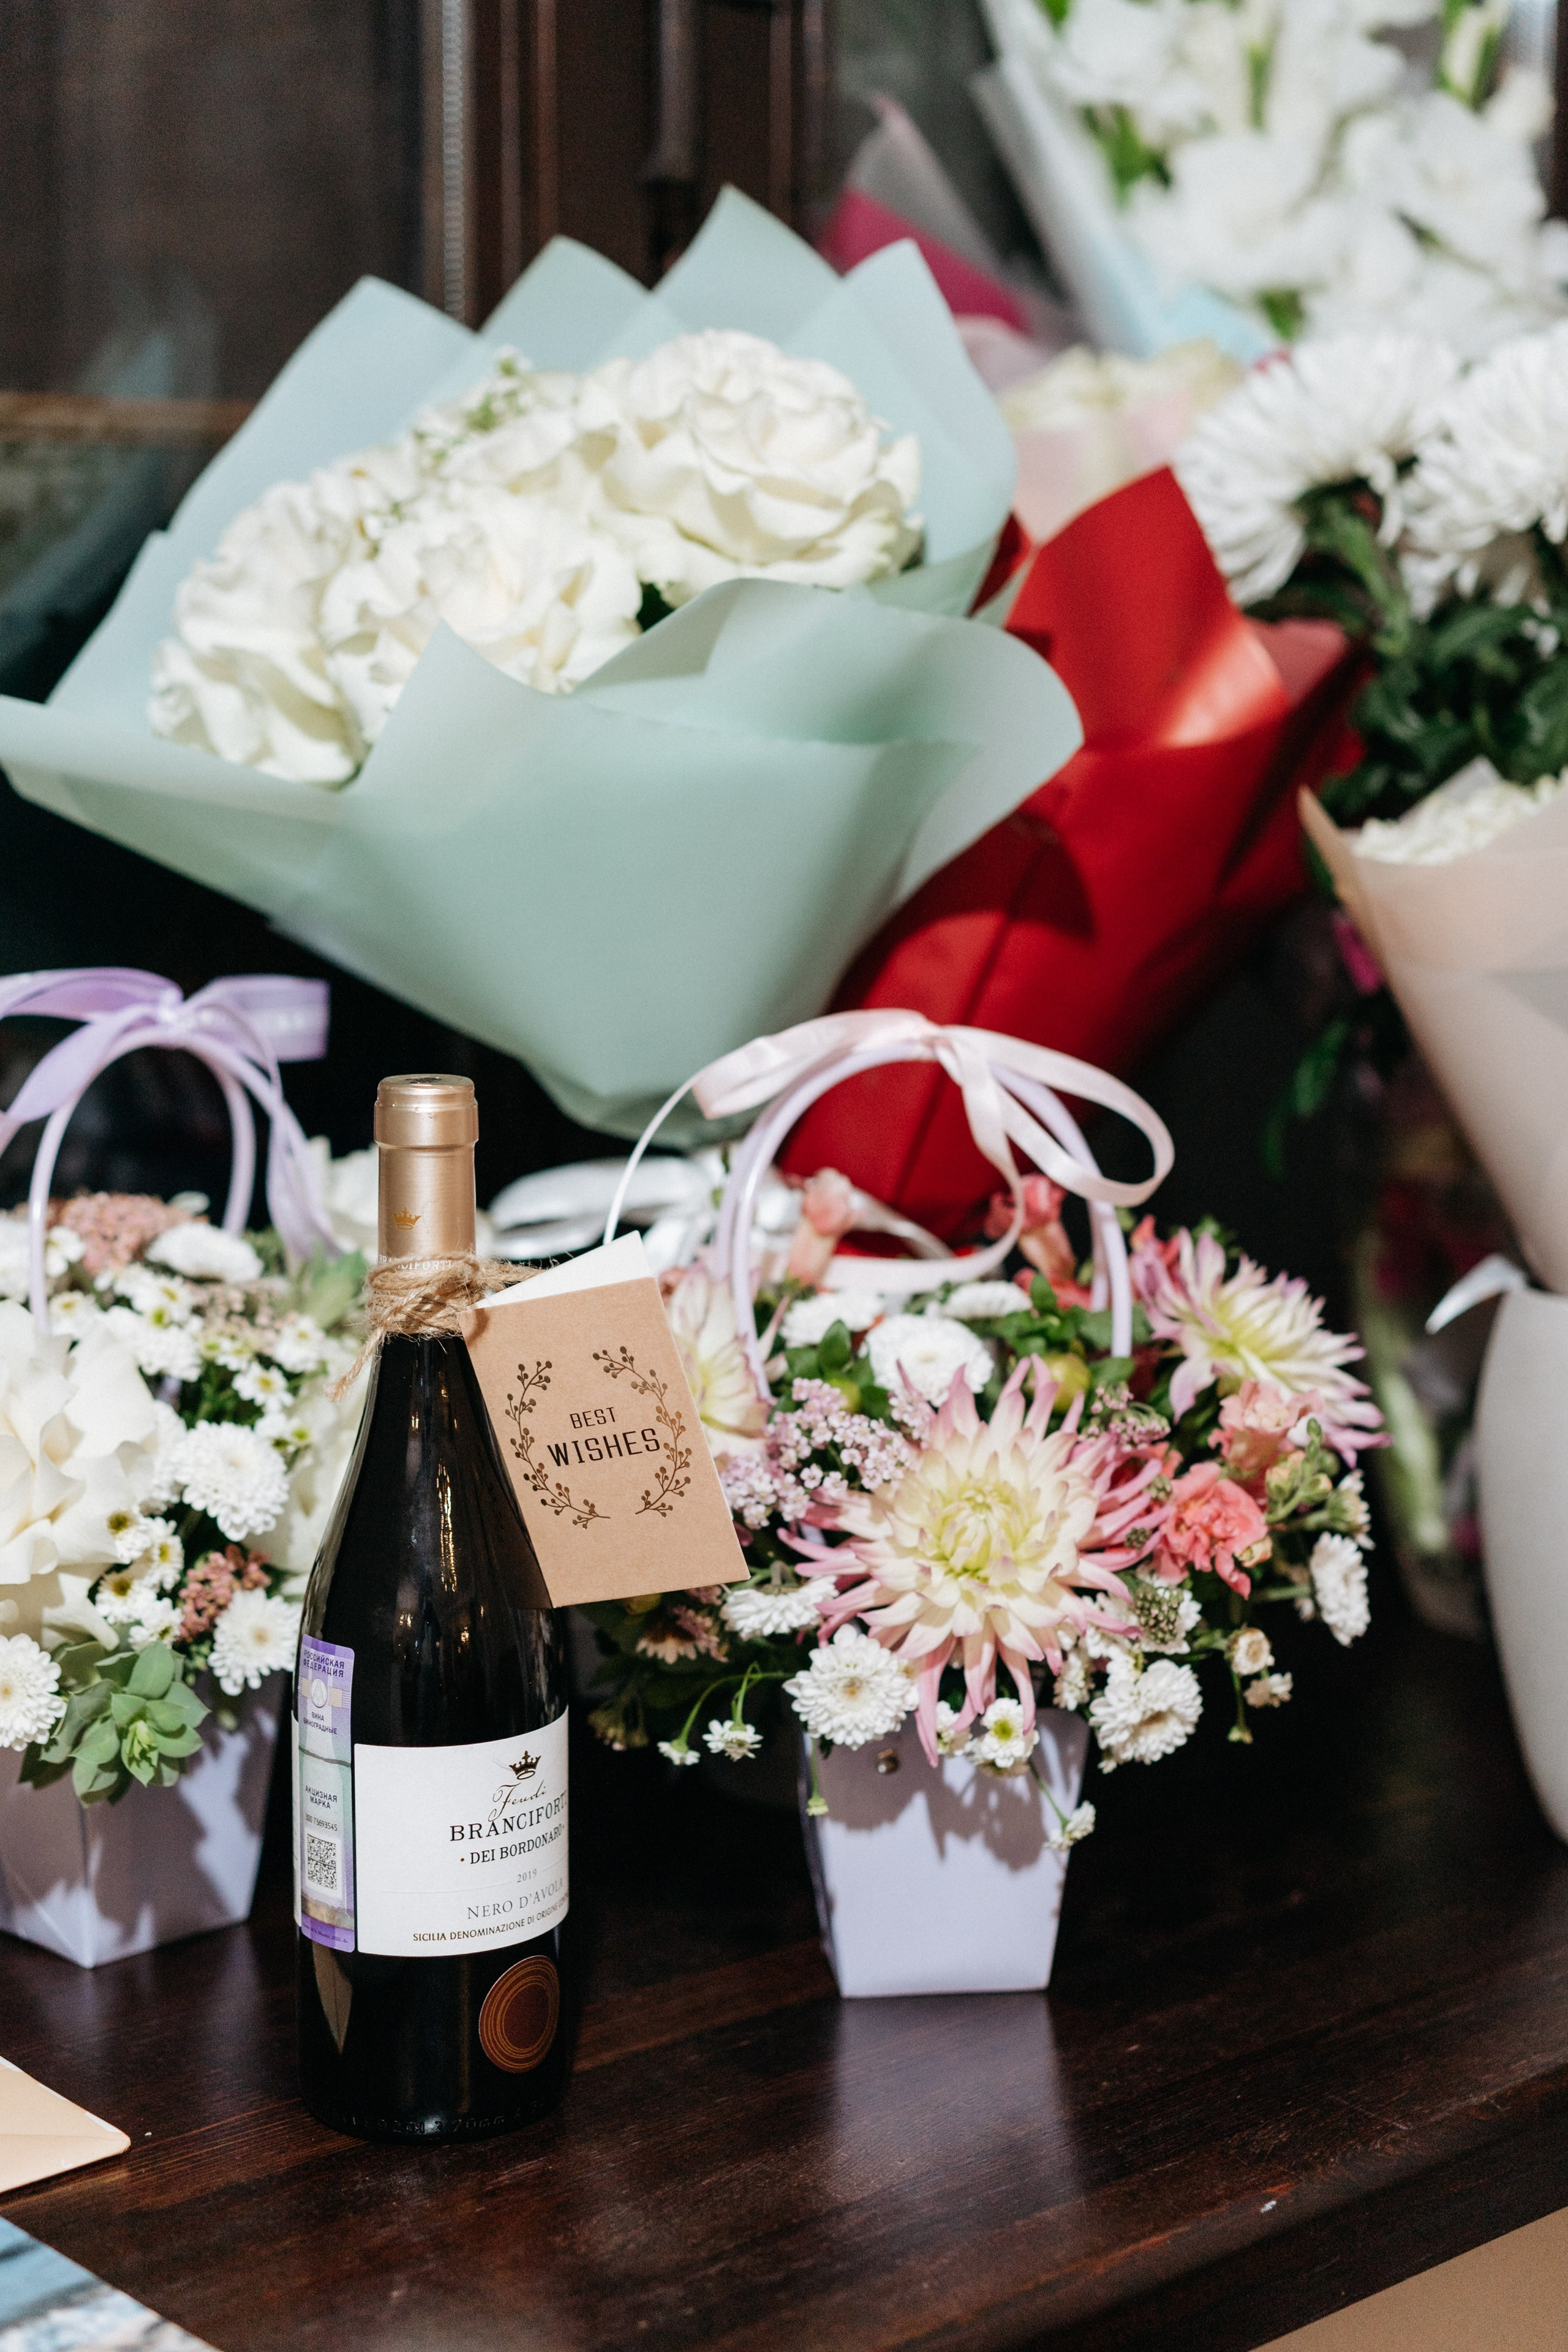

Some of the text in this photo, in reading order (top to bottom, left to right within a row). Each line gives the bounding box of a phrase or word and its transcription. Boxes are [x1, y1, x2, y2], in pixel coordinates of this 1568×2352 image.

[570, 1407, 616, 1429] BEST
[547, 1428, 660, 1467] WISHES
[303, 1659, 344, 1678] ФЕДЕРАЦИЯ
[304, 1649, 344, 1669] РОССИЙСКАЯ
[303, 1717, 337, 1735] ВИНОГРАДНЫЕ
[311, 1711, 325, 1722] ВИНА
[306, 1785, 337, 1803] АКЦИЗНАЯ
[310, 1795, 331, 1809] МАРКА
[488, 1779, 546, 1822] Feudi
[470, 1823, 562, 1864] DEI BORDONARO
[517, 1868, 537, 1883] 2019
[467, 1900, 513, 1920] NERO
[413, 1932, 447, 1941] SICILIA
[450, 1918, 525, 1940] DENOMINAZIONE
[527, 1915, 535, 1924] DI
